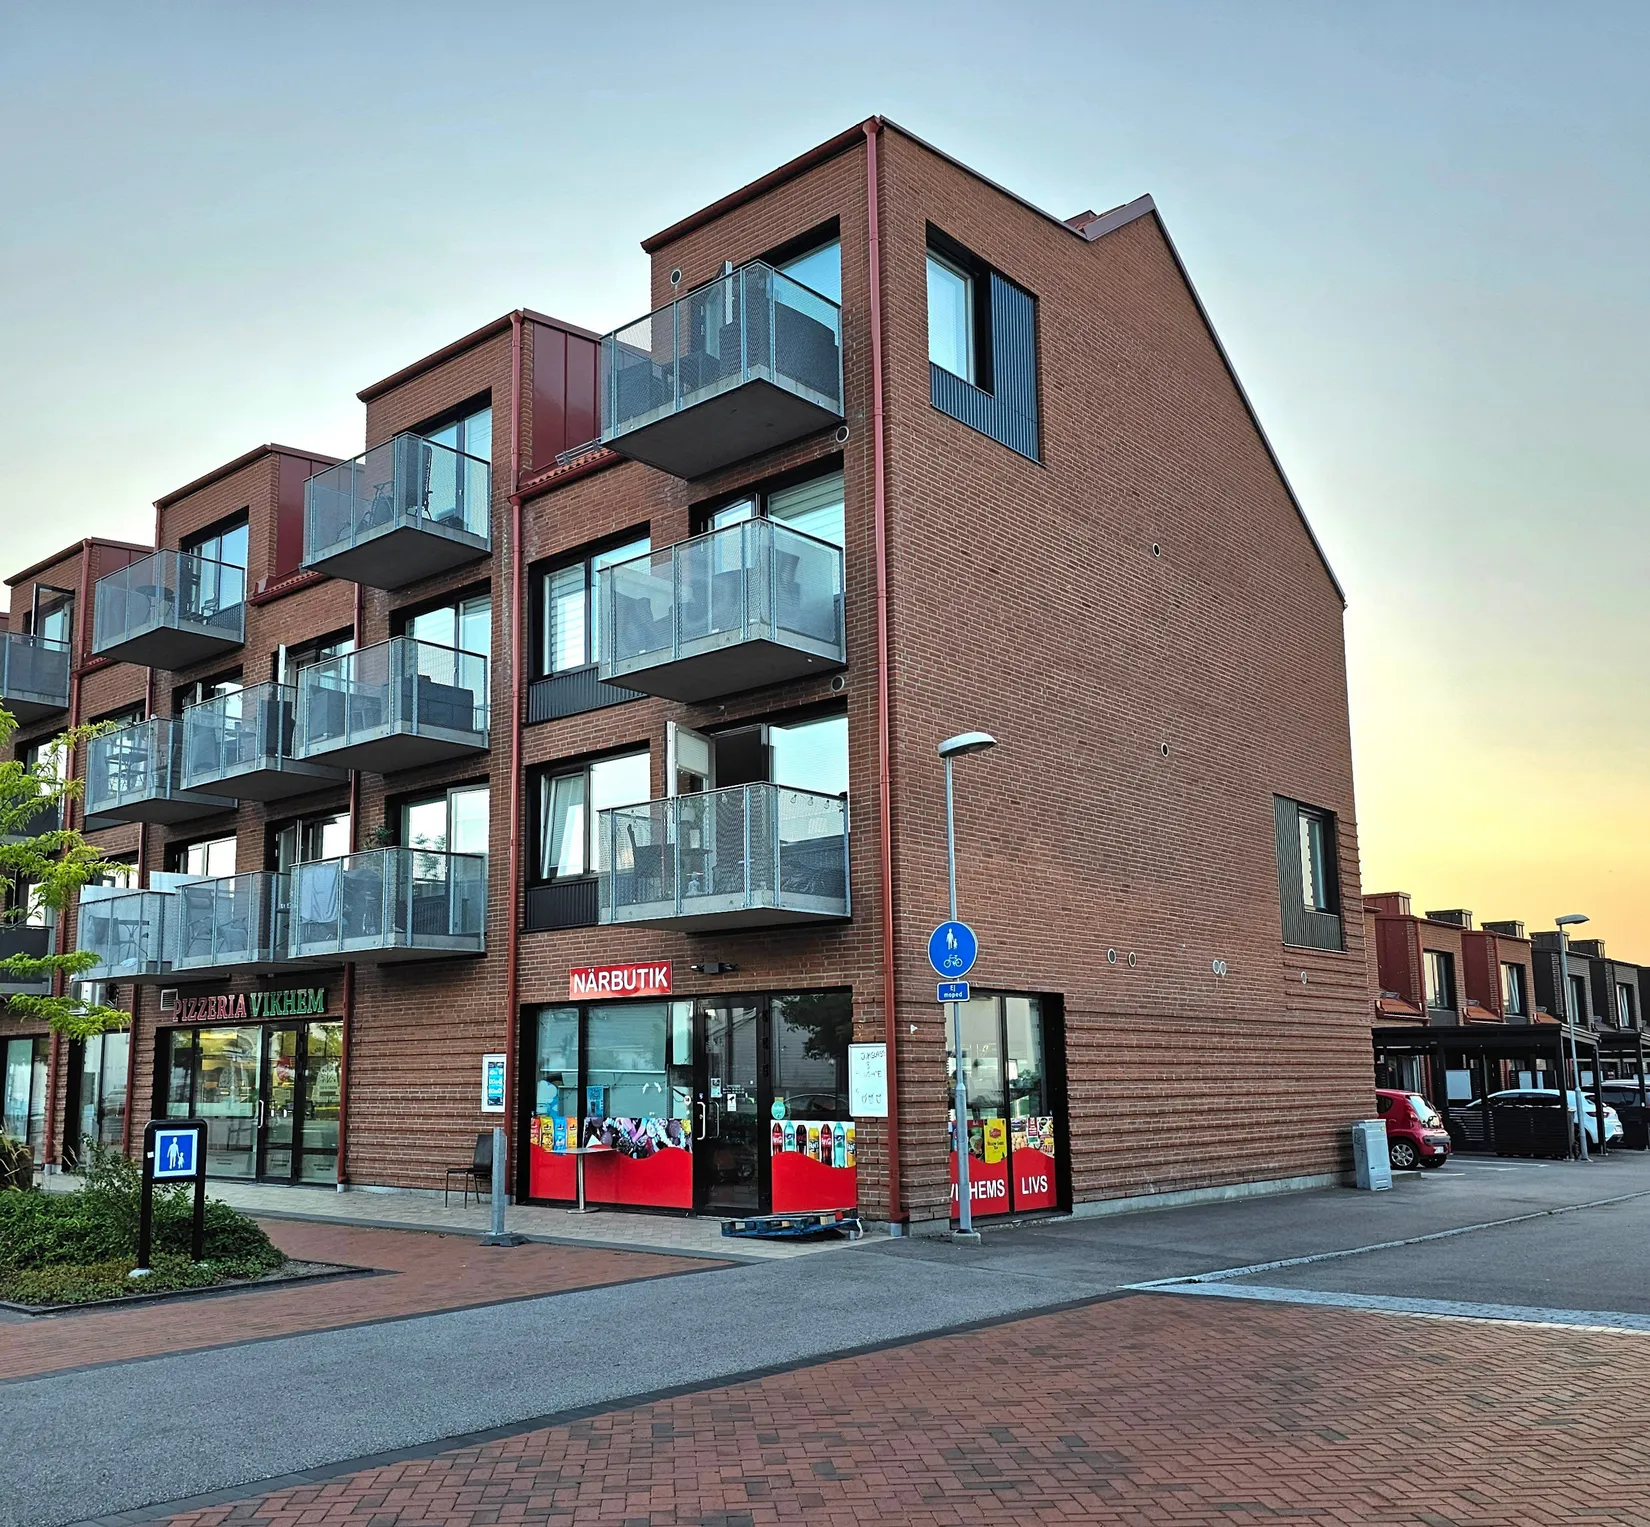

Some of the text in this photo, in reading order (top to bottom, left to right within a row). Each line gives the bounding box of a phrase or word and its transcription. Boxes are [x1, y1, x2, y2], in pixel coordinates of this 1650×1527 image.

[573, 966, 668, 994] NÄRBUTIK
[172, 987, 325, 1022] PIZZERIA VIKHEM
[943, 991, 963, 999] moped
[950, 1175, 1048, 1201] VIHEMS LIVS
